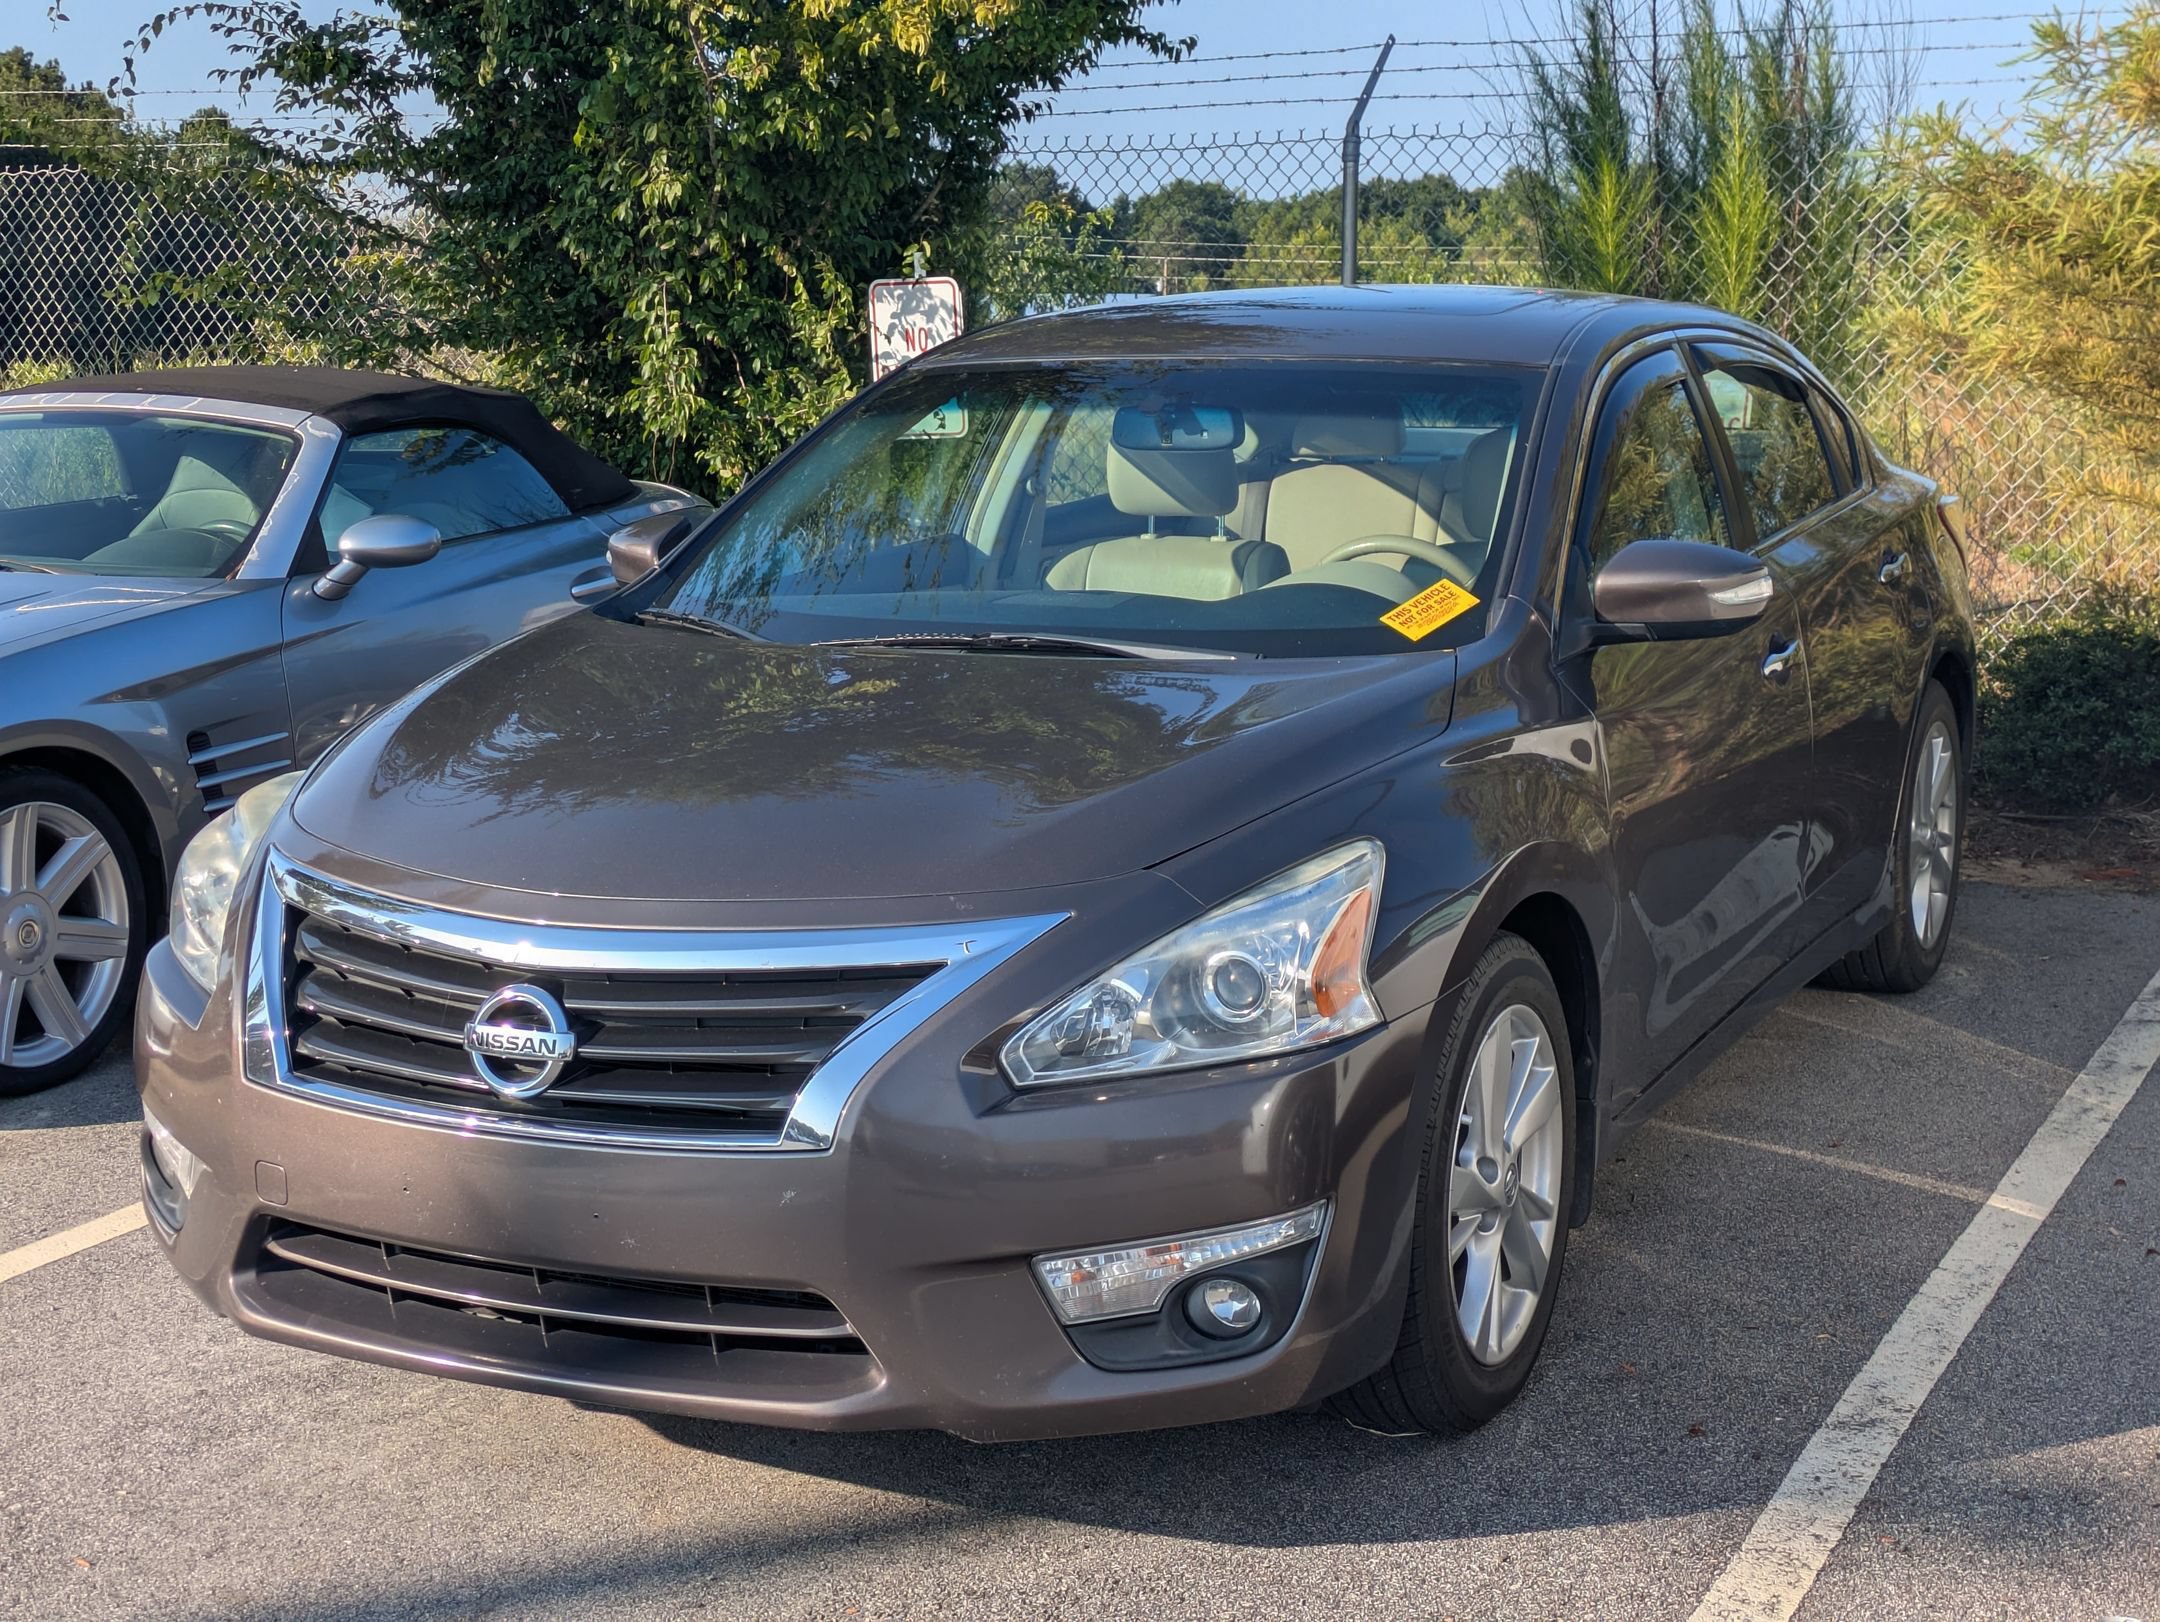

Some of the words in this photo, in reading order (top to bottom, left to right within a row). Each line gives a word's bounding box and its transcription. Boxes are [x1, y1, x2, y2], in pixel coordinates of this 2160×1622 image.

[905, 327, 928, 352] NO
[1387, 606, 1411, 622] THIS
[1410, 583, 1450, 608] VEHICLE
[1399, 615, 1417, 627] NOT
[1416, 604, 1434, 616] FOR
[1434, 590, 1456, 605] SALE
[470, 1032, 557, 1055] NISSAN
